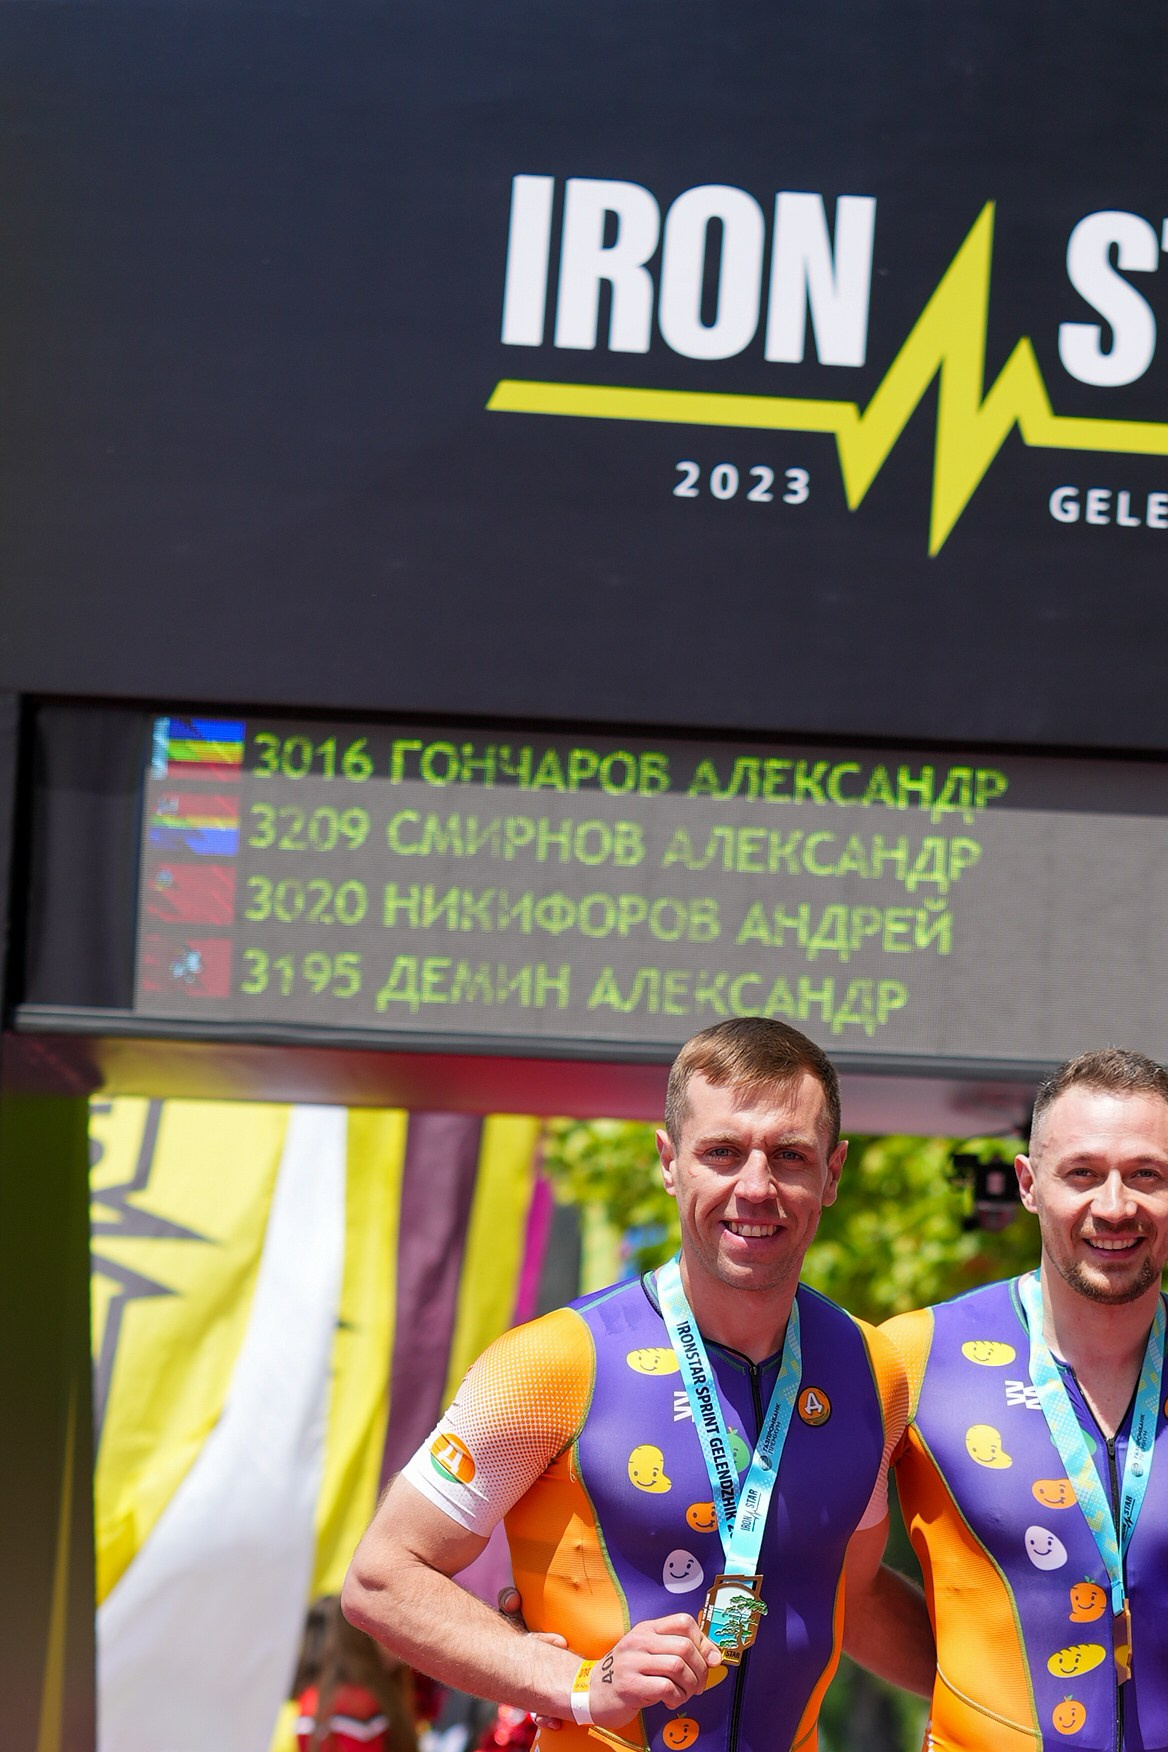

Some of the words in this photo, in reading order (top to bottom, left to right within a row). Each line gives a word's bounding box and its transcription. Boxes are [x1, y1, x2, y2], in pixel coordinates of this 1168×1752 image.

[501, 174, 877, 367] IRON
[673, 461, 811, 505] 2023
[252, 732, 374, 783] 3016
[390, 739, 671, 797] ГОНЧАРОВ
[689, 756, 1008, 824] АЛЕКСАНДР
[249, 802, 370, 851] 3209
[386, 808, 646, 867] СМИРНОВ
[661, 825, 982, 893] АЛЕКСАНДР
[244, 875, 368, 926] 3020
[383, 883, 721, 943] НИКИФОРОВ
[735, 897, 953, 962] АНДРЕЙ
[241, 948, 363, 998] 3195
[374, 955, 571, 1015] ДЕМИН
[586, 966, 909, 1037] АЛЕКСАНДР
[676, 1320, 707, 1385] IRONSTAR
[696, 1384, 720, 1434] SPRINT
[710, 1437, 737, 1521] GELENDZHIK
[745, 1488, 759, 1509] STAR
[1123, 1495, 1133, 1518] STAR
